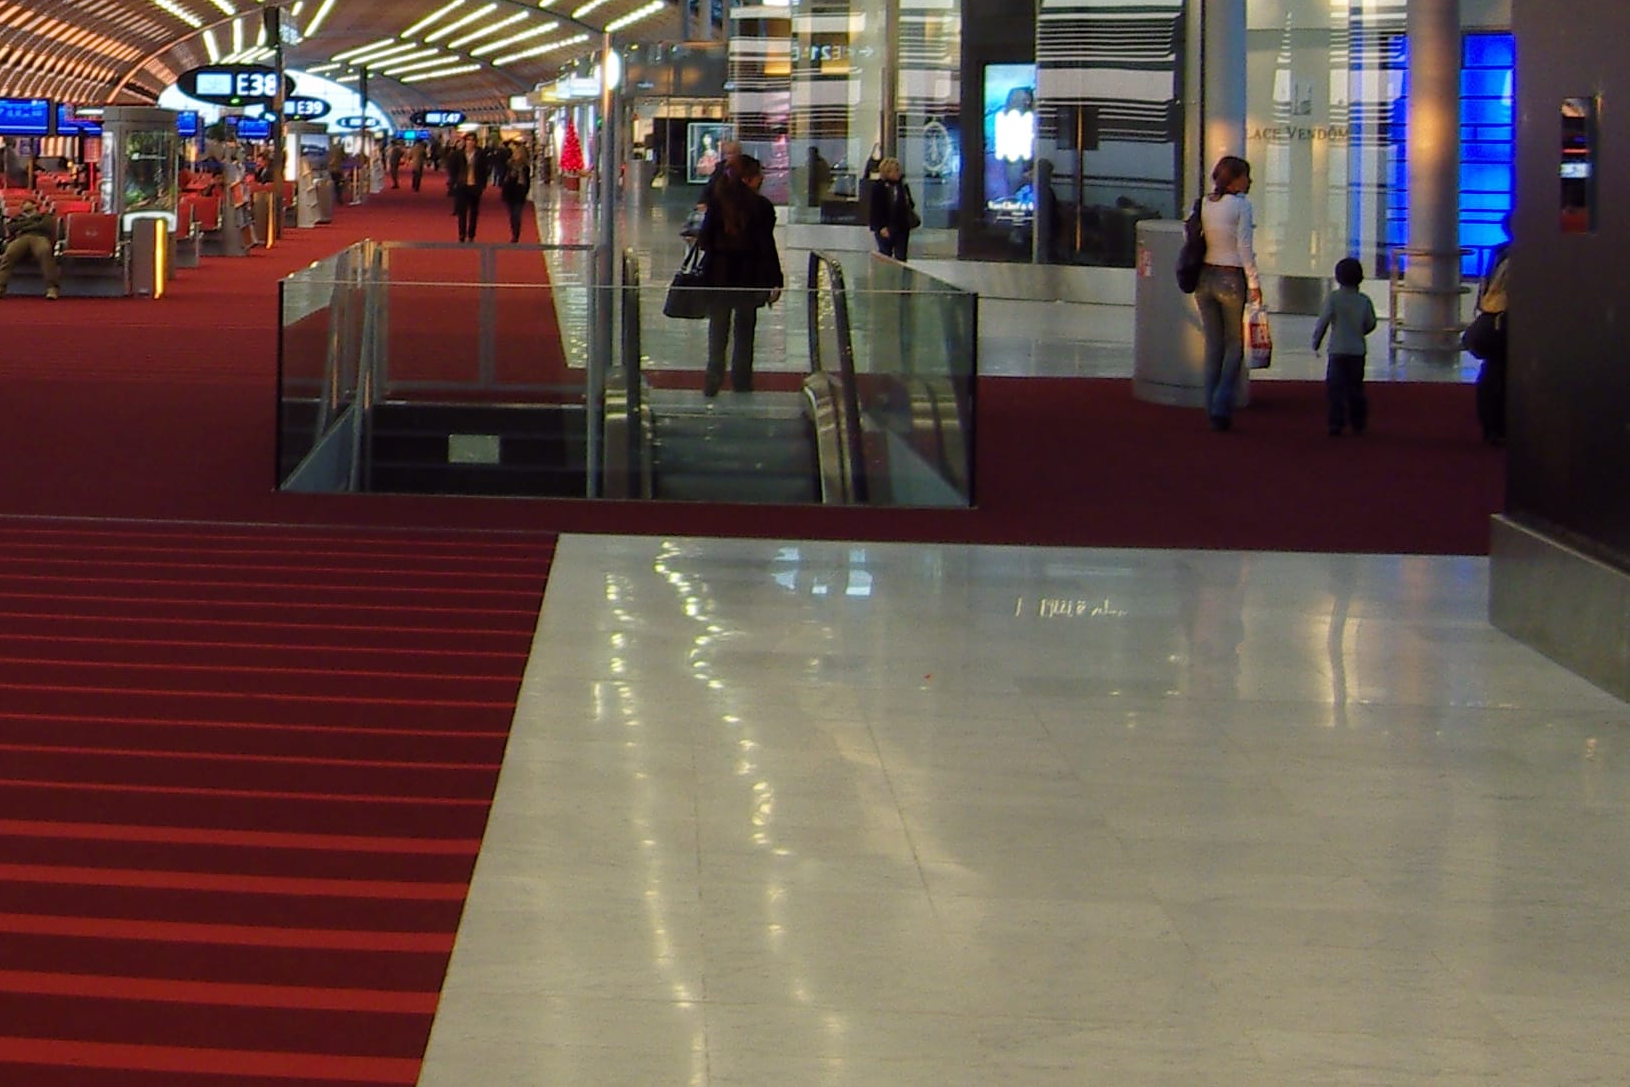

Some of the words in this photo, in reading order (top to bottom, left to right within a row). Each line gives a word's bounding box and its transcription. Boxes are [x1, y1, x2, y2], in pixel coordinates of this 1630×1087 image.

[236, 73, 277, 96] E38
[297, 100, 323, 115] E39
[1243, 127, 1279, 140] LACE
[1287, 125, 1350, 141] VENDÔM
